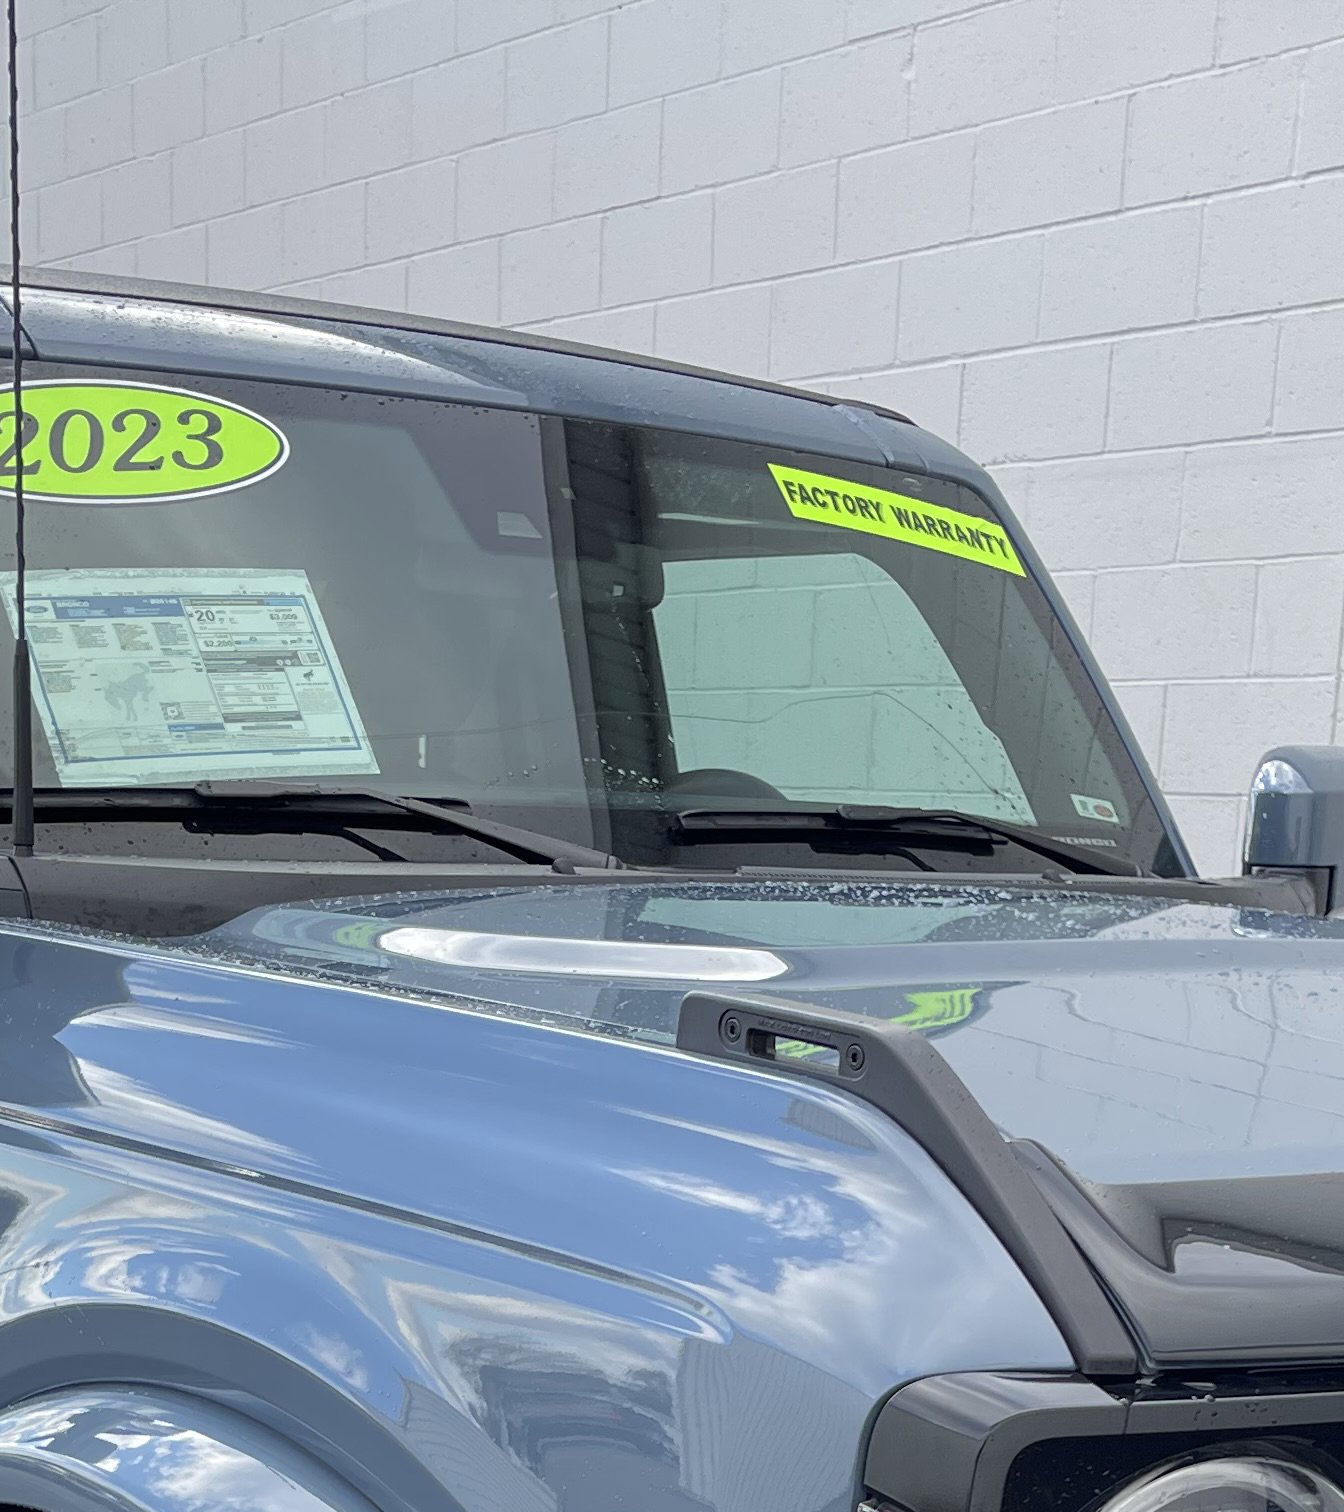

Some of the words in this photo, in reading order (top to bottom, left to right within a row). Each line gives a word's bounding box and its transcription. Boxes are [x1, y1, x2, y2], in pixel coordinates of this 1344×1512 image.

[782, 480, 886, 523] FACTORY
[891, 505, 1009, 560] WARRANTY
[194, 609, 216, 622] 20
